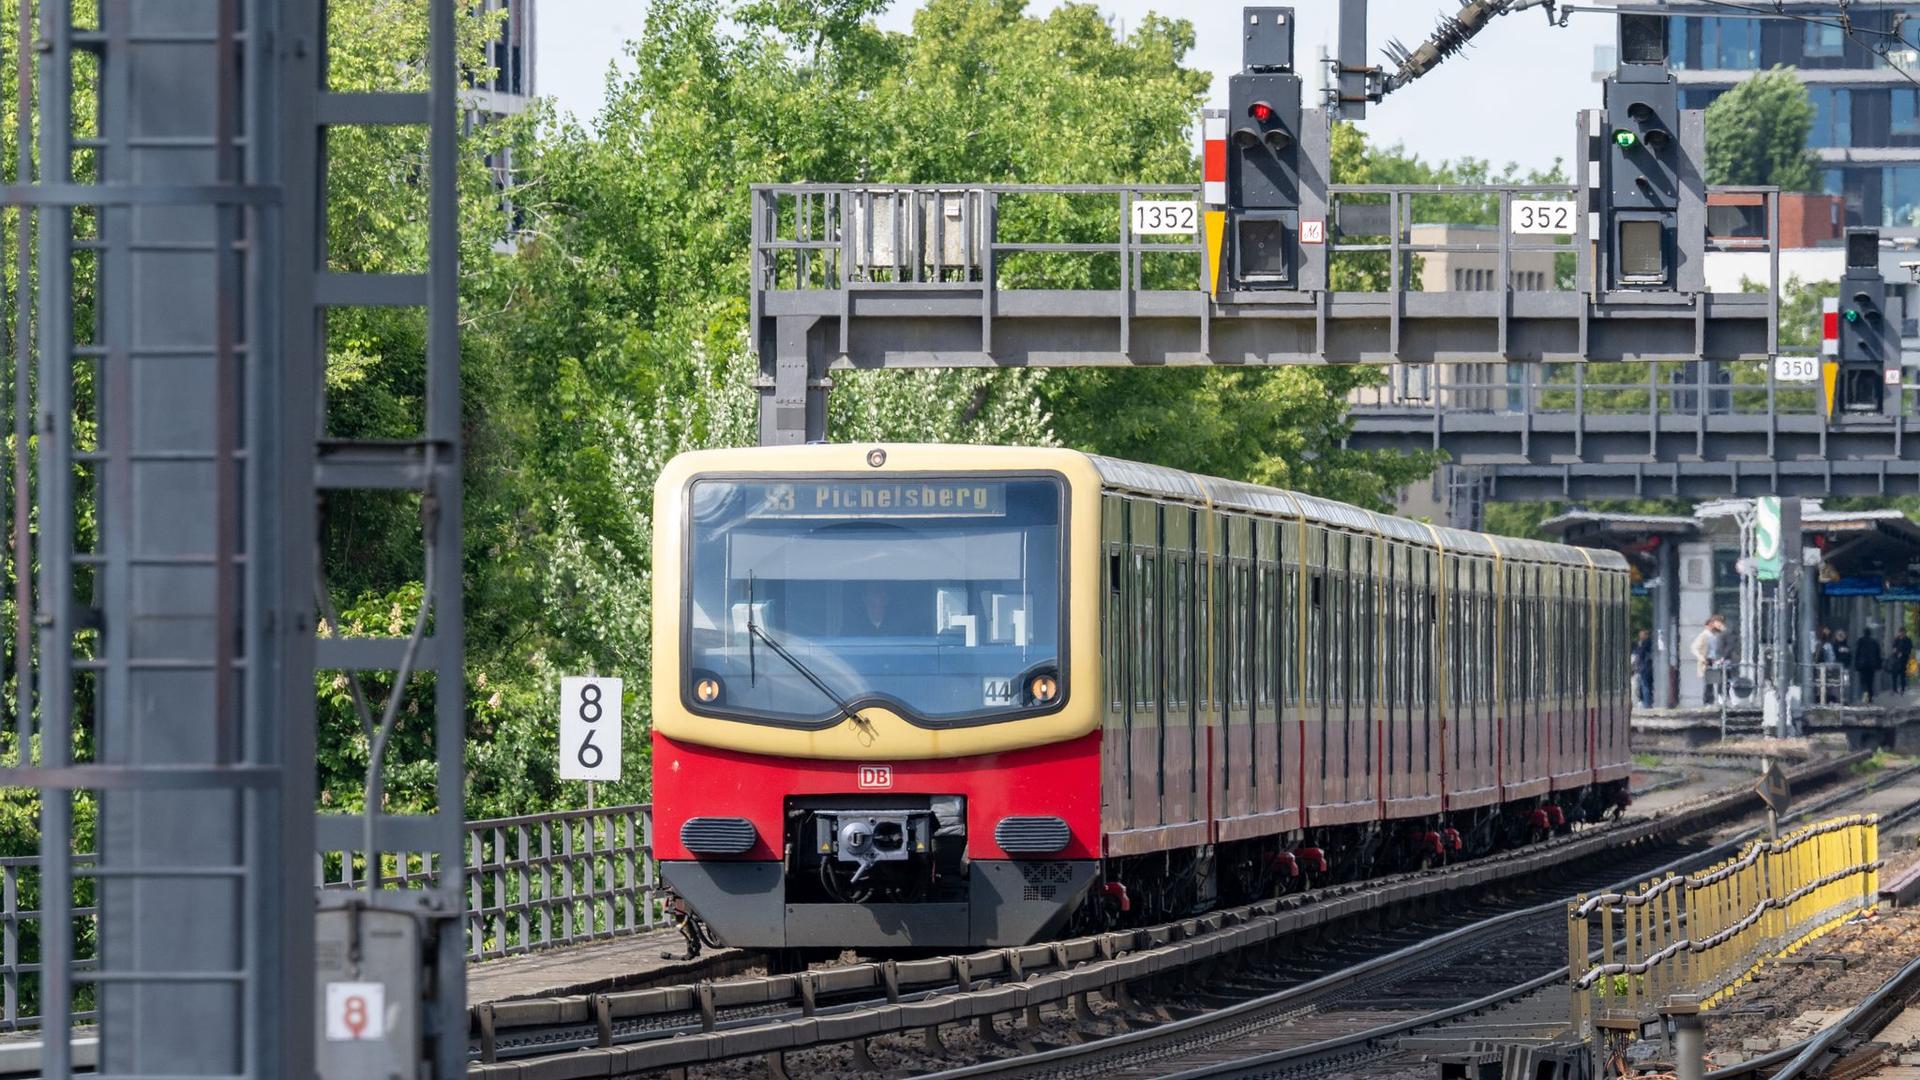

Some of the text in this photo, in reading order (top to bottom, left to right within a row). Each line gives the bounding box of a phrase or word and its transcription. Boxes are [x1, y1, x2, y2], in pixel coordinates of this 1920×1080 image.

[1137, 206, 1194, 229] 1352
[1521, 206, 1567, 229] 352
[1782, 361, 1813, 376] 350
[816, 484, 988, 509] Pichelsberg
[579, 683, 603, 723] 8
[985, 681, 1011, 702] 44
[577, 729, 603, 768] 6
[863, 769, 888, 784] DB
